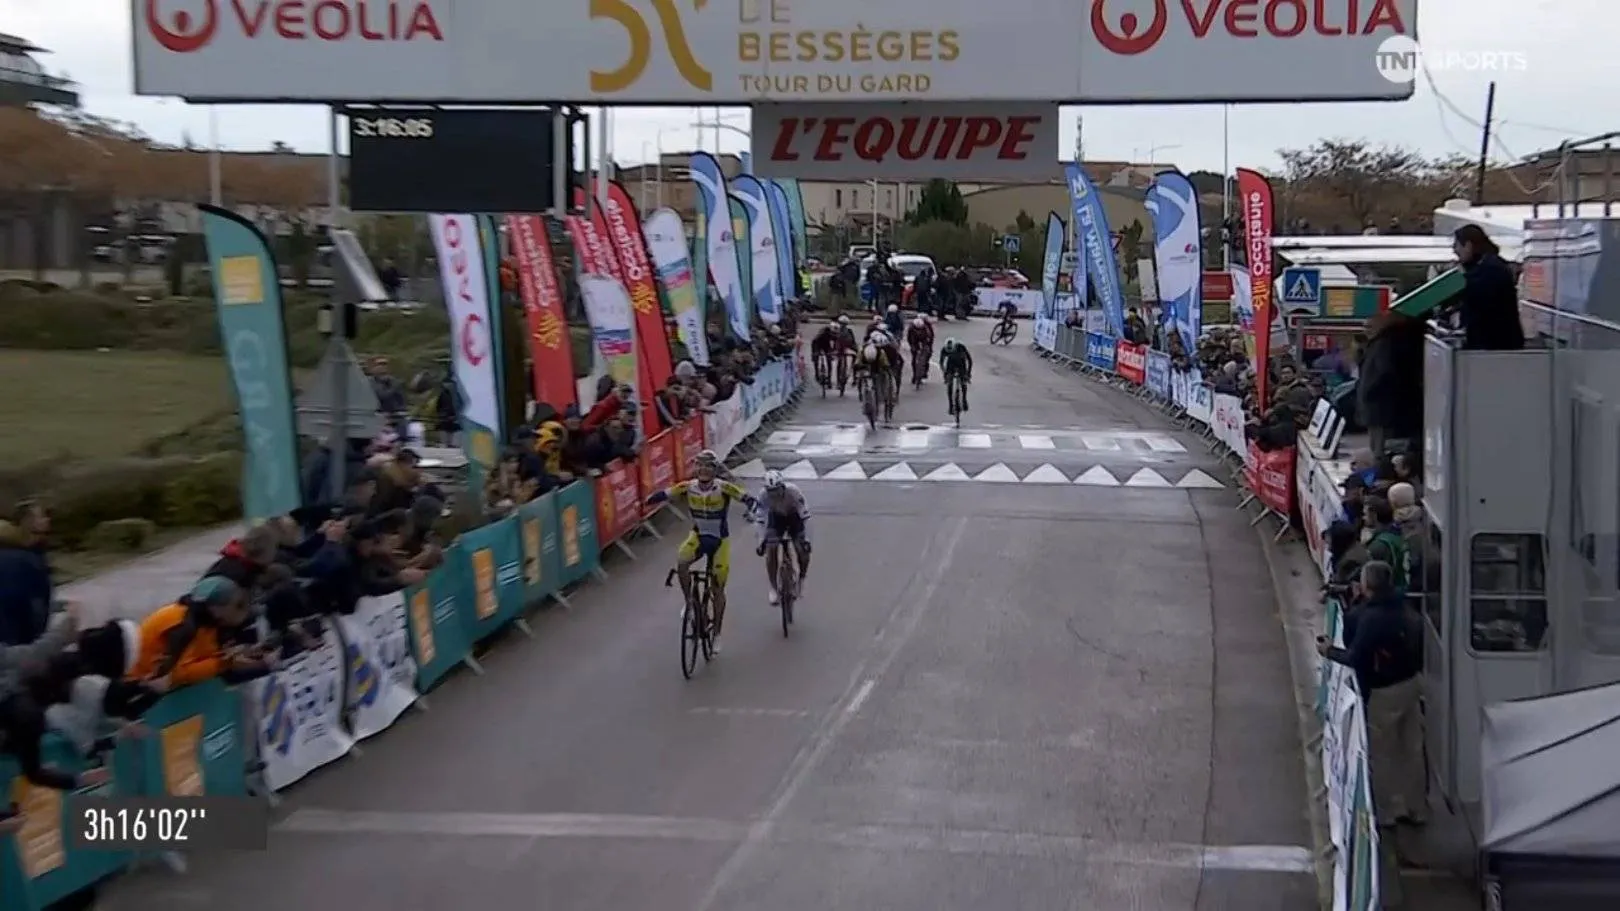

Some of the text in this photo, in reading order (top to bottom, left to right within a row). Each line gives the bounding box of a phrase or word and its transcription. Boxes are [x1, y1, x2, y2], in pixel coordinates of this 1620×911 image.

[231, 0, 444, 41] VEOLIA
[1178, 0, 1406, 38] VEOLIA
[738, 23, 961, 63] BESSÈGES
[738, 73, 932, 94] TOUR DU GARD
